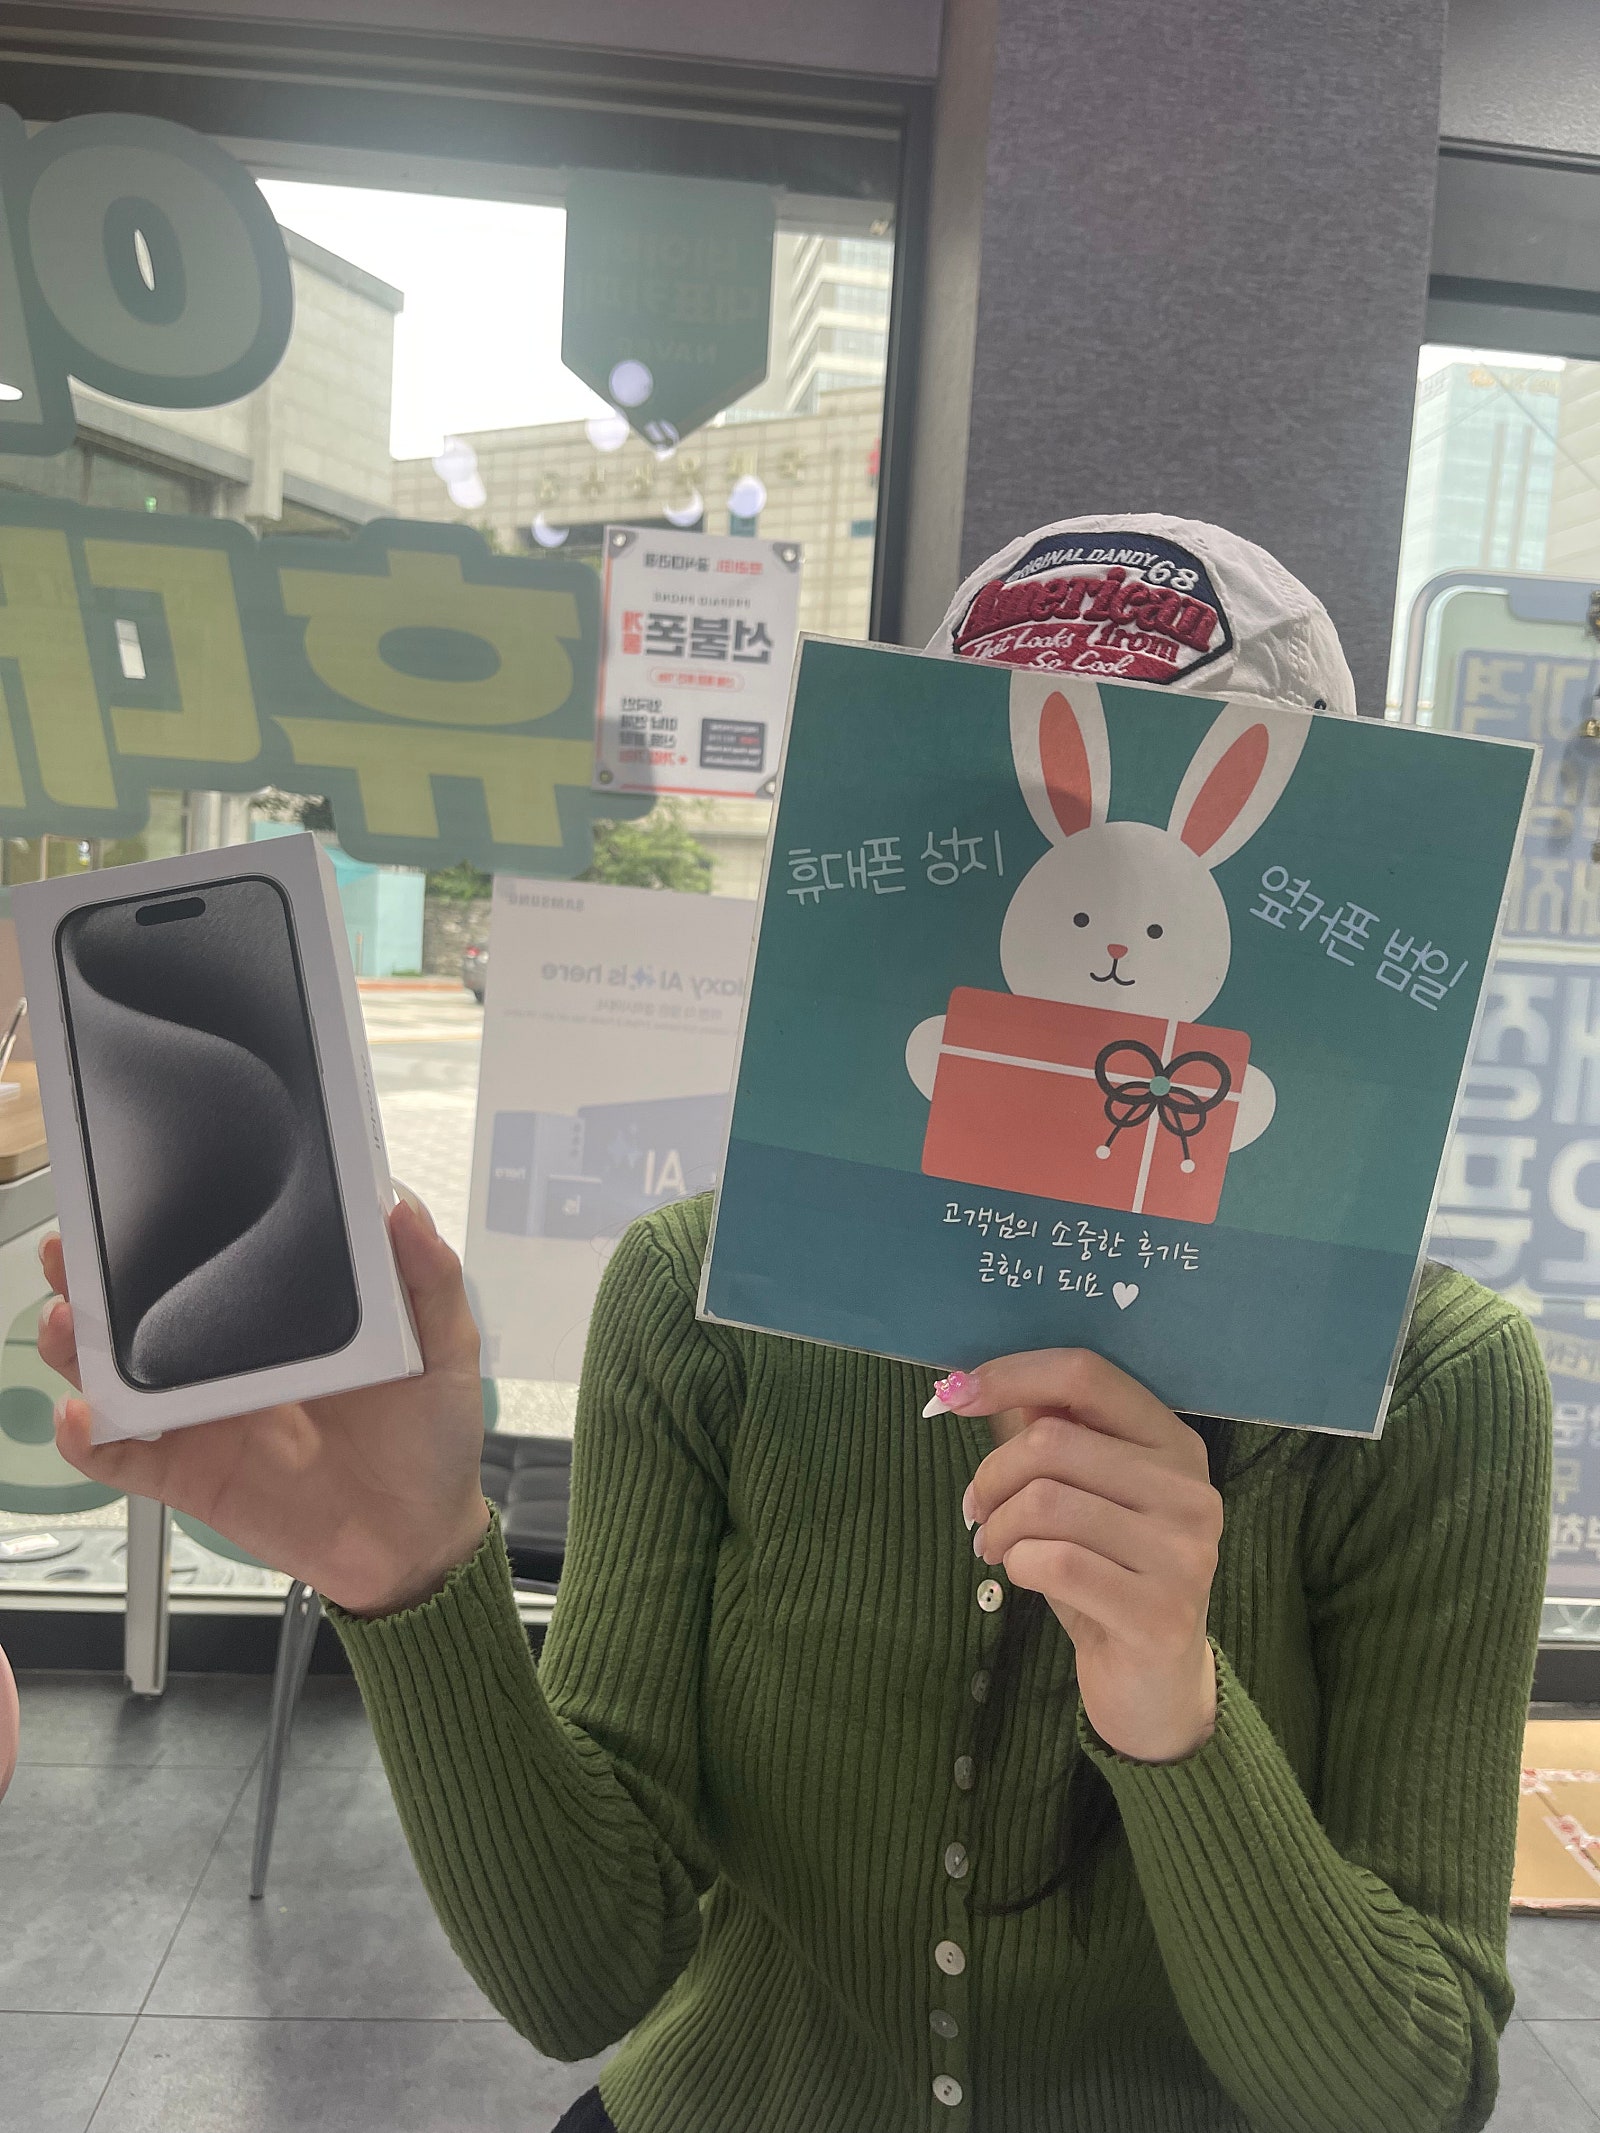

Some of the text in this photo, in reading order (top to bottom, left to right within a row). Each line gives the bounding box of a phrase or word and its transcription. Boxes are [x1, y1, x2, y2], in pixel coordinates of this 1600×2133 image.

[1006, 548, 1200, 591] ORIGINAL DANDY 68
[954, 567, 1218, 653] American
[974, 627, 1079, 659] That Looks
[1028, 649, 1136, 675] So Cool
[786, 826, 1004, 905] 휴대폰 성지
[1250, 865, 1469, 1011] 옆커폰 범일
[943, 1202, 1200, 1271] 고객님의 소중한 후기는
[978, 1250, 1104, 1298] 큰힘이 되요
